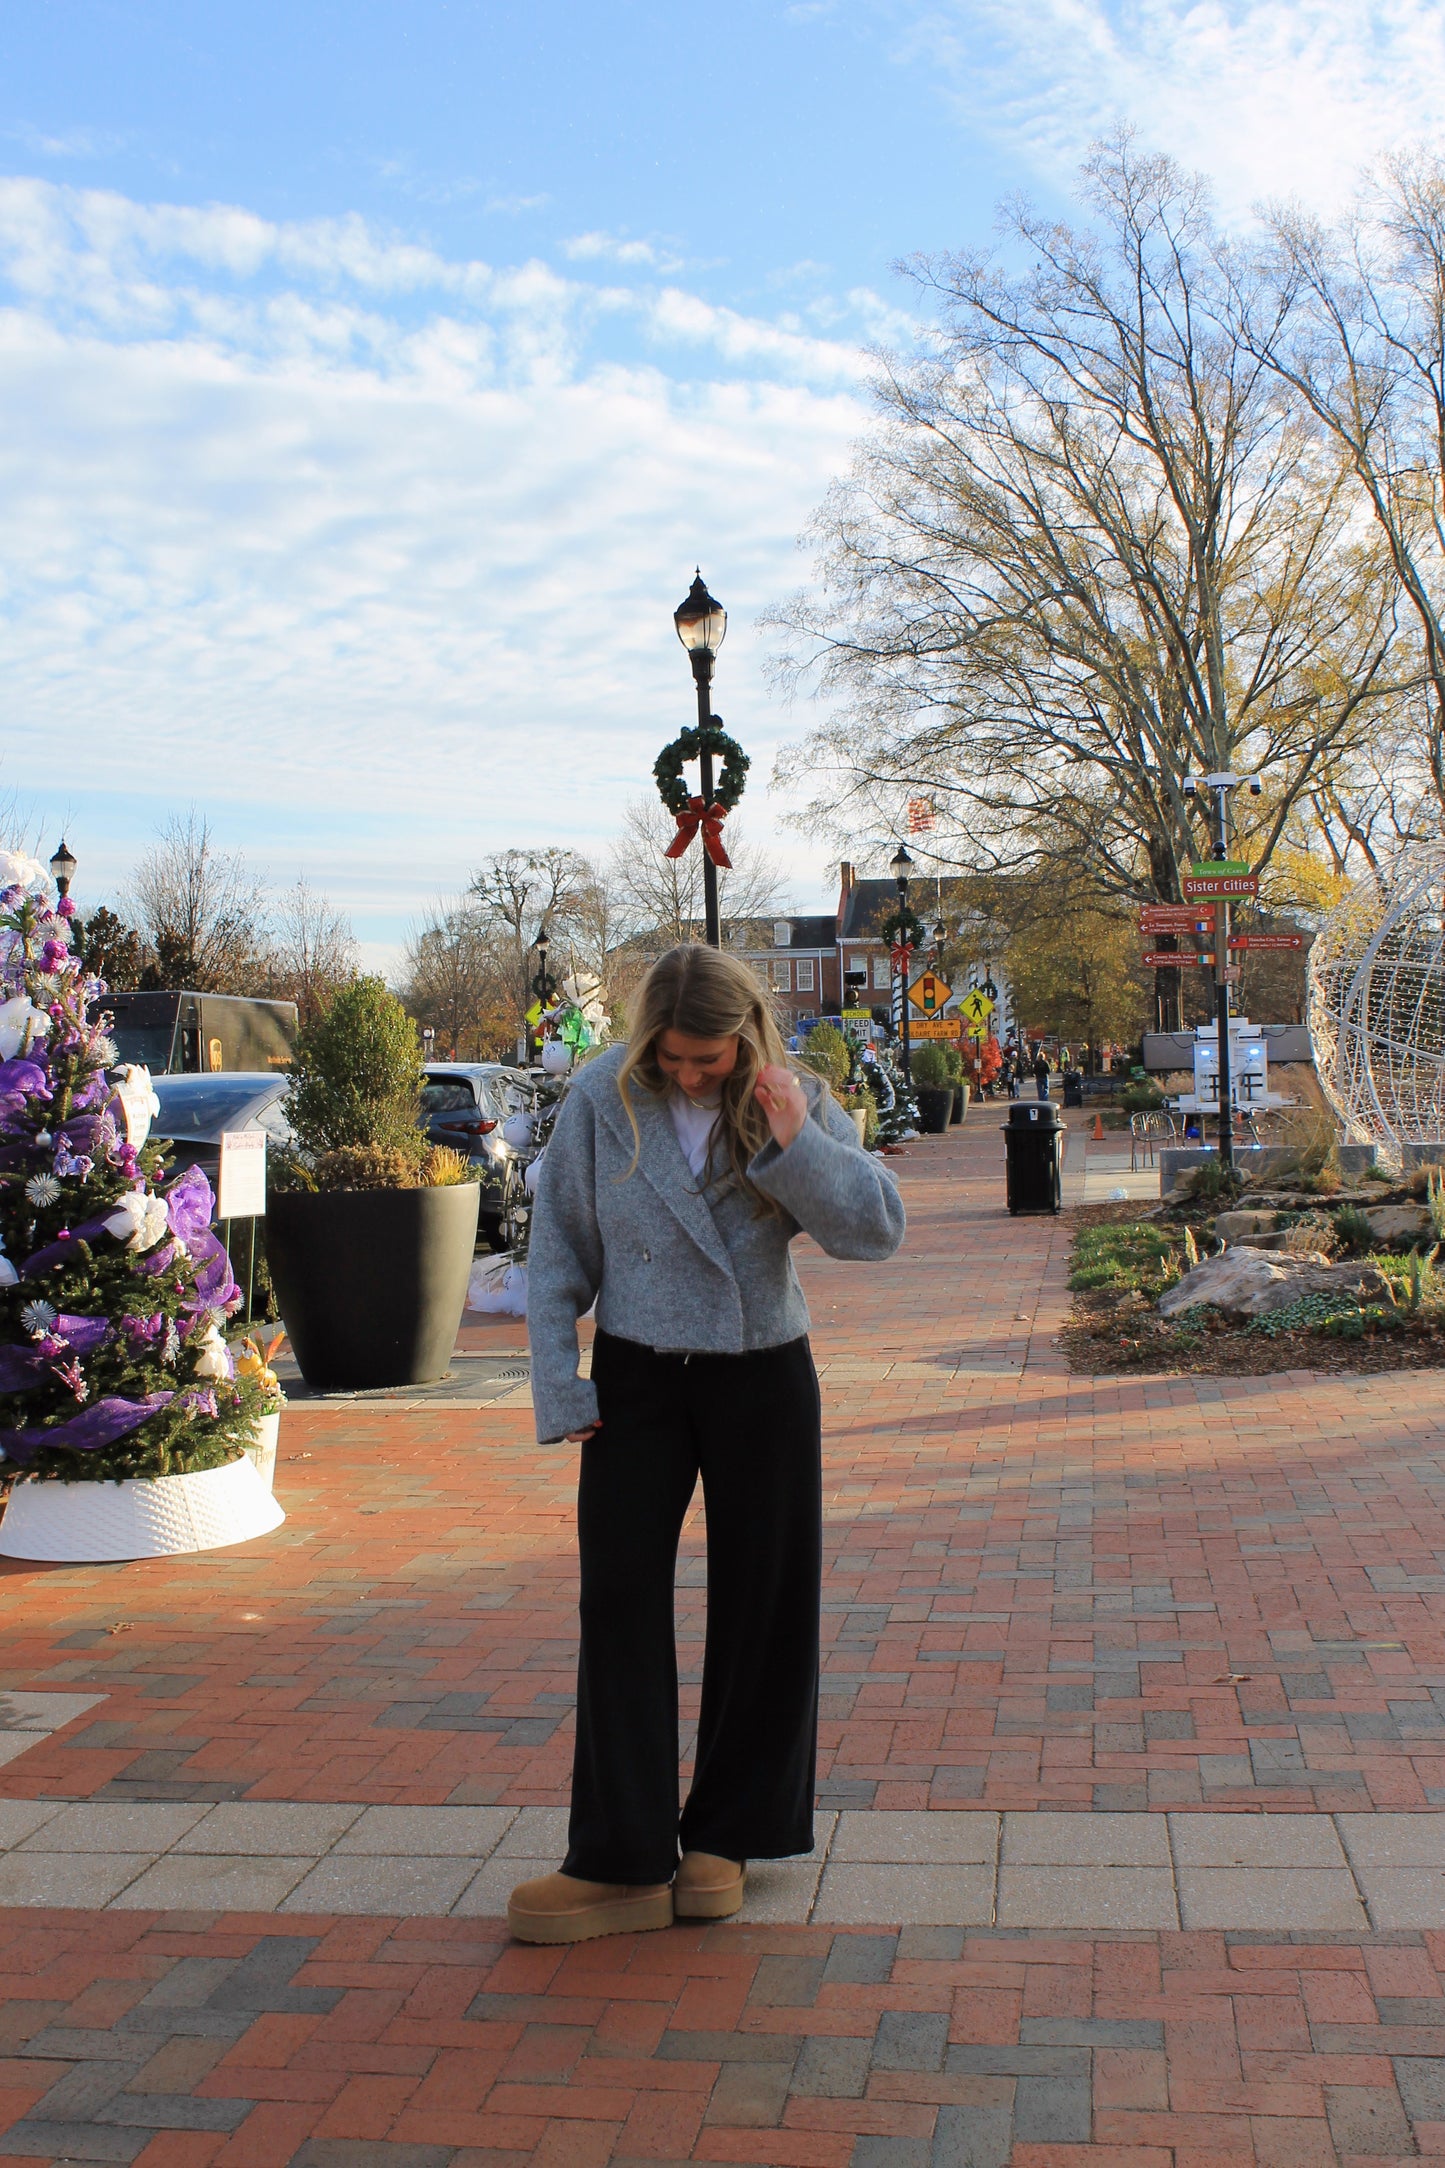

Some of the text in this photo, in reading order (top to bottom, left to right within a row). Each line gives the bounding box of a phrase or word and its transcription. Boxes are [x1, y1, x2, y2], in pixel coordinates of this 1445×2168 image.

[1186, 879, 1255, 892] Sister Cities
[844, 1019, 869, 1028] SPEED
[950, 1029, 959, 1037] RD
